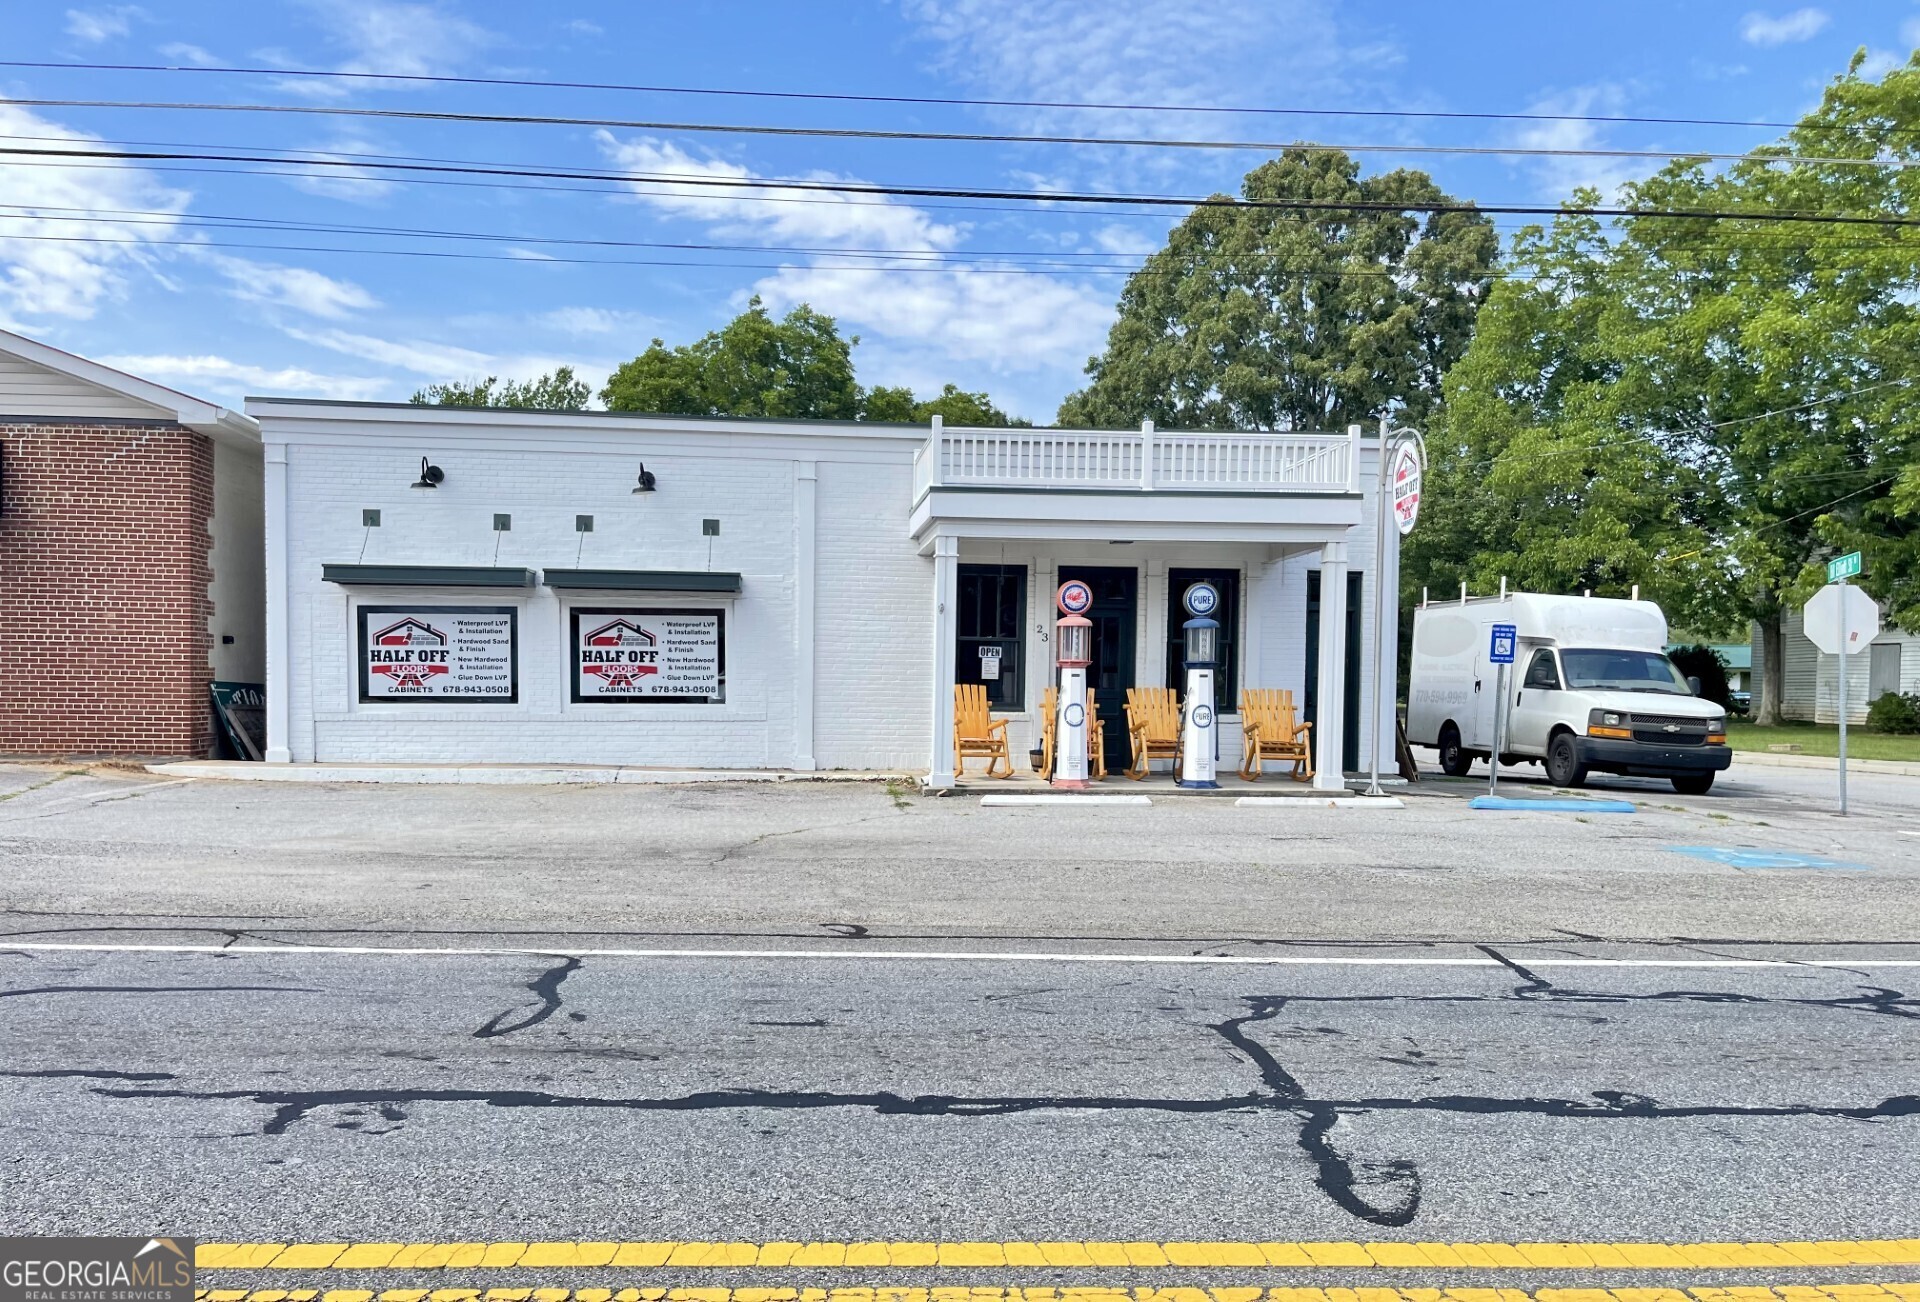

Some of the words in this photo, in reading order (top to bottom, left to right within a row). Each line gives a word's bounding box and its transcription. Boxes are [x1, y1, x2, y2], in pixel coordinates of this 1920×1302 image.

[1194, 596, 1211, 604] PURE
[370, 650, 414, 662] HALF
[418, 650, 450, 662] OFF
[981, 648, 1000, 656] OPEN
[582, 651, 625, 662] HALF
[628, 651, 658, 662] OFF
[391, 665, 429, 673] FLOORS
[602, 665, 638, 673] FLOORS
